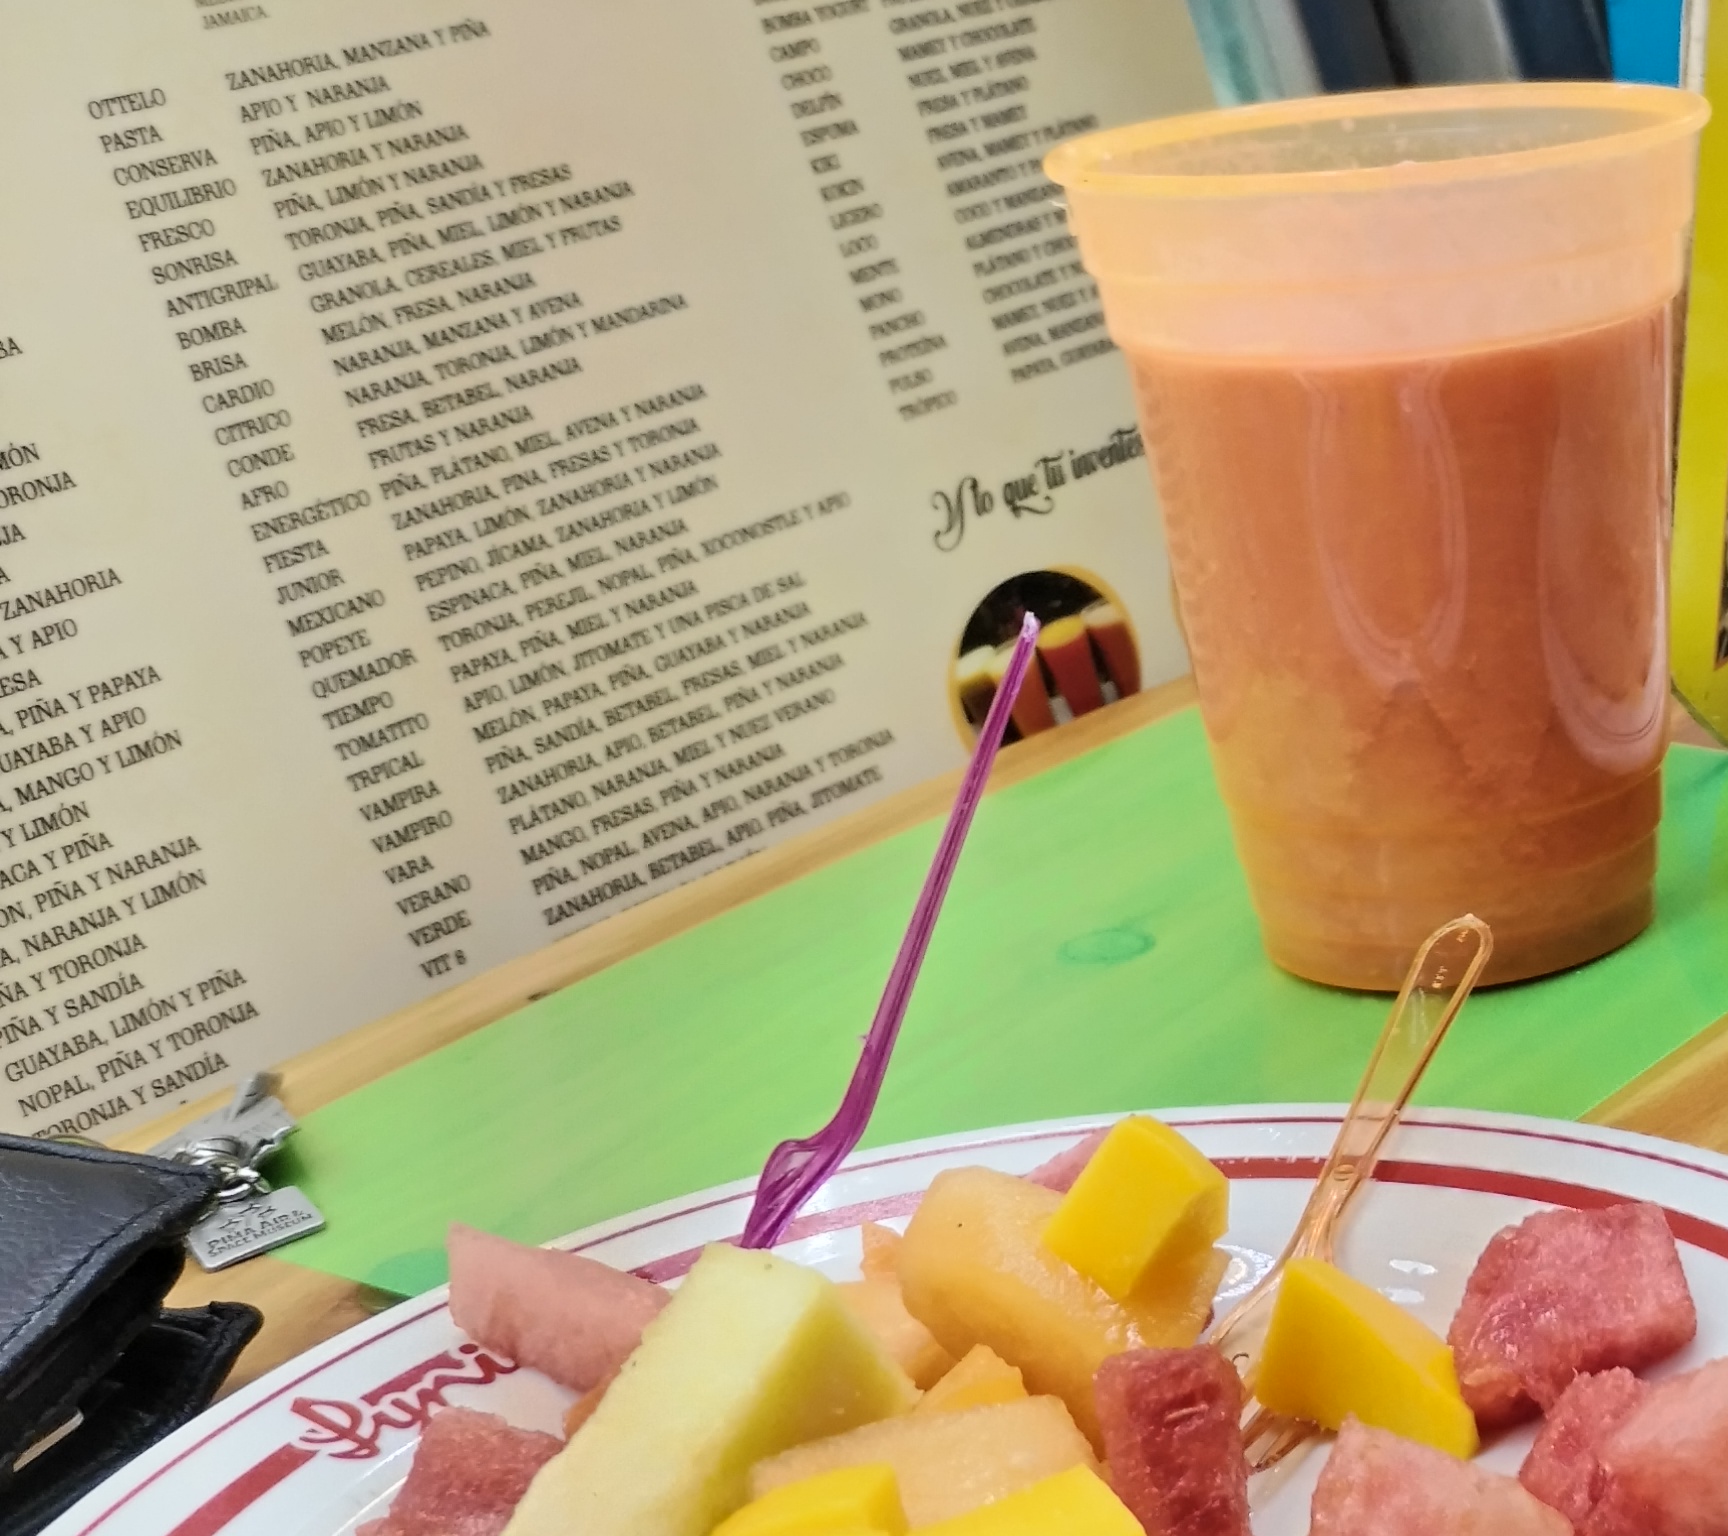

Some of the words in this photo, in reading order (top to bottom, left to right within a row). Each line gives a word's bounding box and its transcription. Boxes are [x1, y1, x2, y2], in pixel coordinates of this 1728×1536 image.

[87, 88, 166, 119] OTTELO
[98, 124, 164, 153] PASTA
[112, 148, 218, 186] CONSERVA
[124, 178, 236, 219] EQUILIBRIO
[137, 218, 215, 252] FRESCO
[150, 249, 238, 284] SONRISA
[166, 273, 279, 317] ANTIGRIPAL
[175, 317, 247, 349] BOMBA
[187, 352, 248, 382] BRISA
[201, 378, 274, 413] CARDIO
[214, 409, 291, 445] CITRICO
[226, 443, 295, 477] CONDE
[240, 480, 289, 510] AFRO
[1002, 471, 1053, 518] que
[249, 489, 370, 542] ENERGÉTICO
[262, 538, 329, 573] FIESTA
[2, 568, 122, 620] ZANAHORIA
[276, 568, 345, 605] JUNIOR
[285, 589, 385, 636] MEXICANO
[9, 634, 24, 654] Y
[31, 618, 77, 649] APIO
[297, 628, 371, 667] POPEYE
[310, 648, 417, 698] QUEMADOR
[14, 698, 68, 729] PIÑA
[69, 690, 84, 709] Y
[86, 665, 162, 703] PAPAYA
[321, 691, 393, 729] TIEMPO
[80, 724, 94, 743] Y
[100, 706, 146, 738] APIO
[333, 713, 429, 760] TOMATITO
[13, 762, 94, 805] MANGO
[98, 755, 112, 774] Y
[114, 730, 182, 768] LIMÓN
[359, 780, 441, 821] VAMPIRA
[1, 828, 16, 847] Y
[18, 801, 90, 841] LIMÓN
[370, 809, 453, 853] VAMPIRO
[44, 851, 59, 870] Y
[60, 832, 114, 864] PIÑA
[383, 855, 434, 884] VARA
[32, 880, 87, 913] PIÑA
[89, 873, 102, 891] Y
[104, 836, 201, 884] NARANJA
[395, 874, 471, 916] VERANO
[20, 905, 121, 957] NARANJA
[123, 897, 136, 915] Y
[140, 870, 207, 909] LIMÓN
[407, 909, 471, 946] VERDE
[31, 972, 46, 991] Y
[47, 933, 147, 984] TORONJA
[45, 1005, 59, 1025] Y
[63, 973, 145, 1018] SANDÍA
[108, 995, 178, 1038] LIMÓN
[179, 987, 194, 1007] Y
[195, 968, 247, 1001] PIÑA
[95, 1049, 149, 1083] PIÑA
[149, 1039, 163, 1059] Y
[165, 1001, 259, 1051] TORONJA
[131, 1085, 147, 1105] Y
[150, 1052, 229, 1098] SANDÍA
